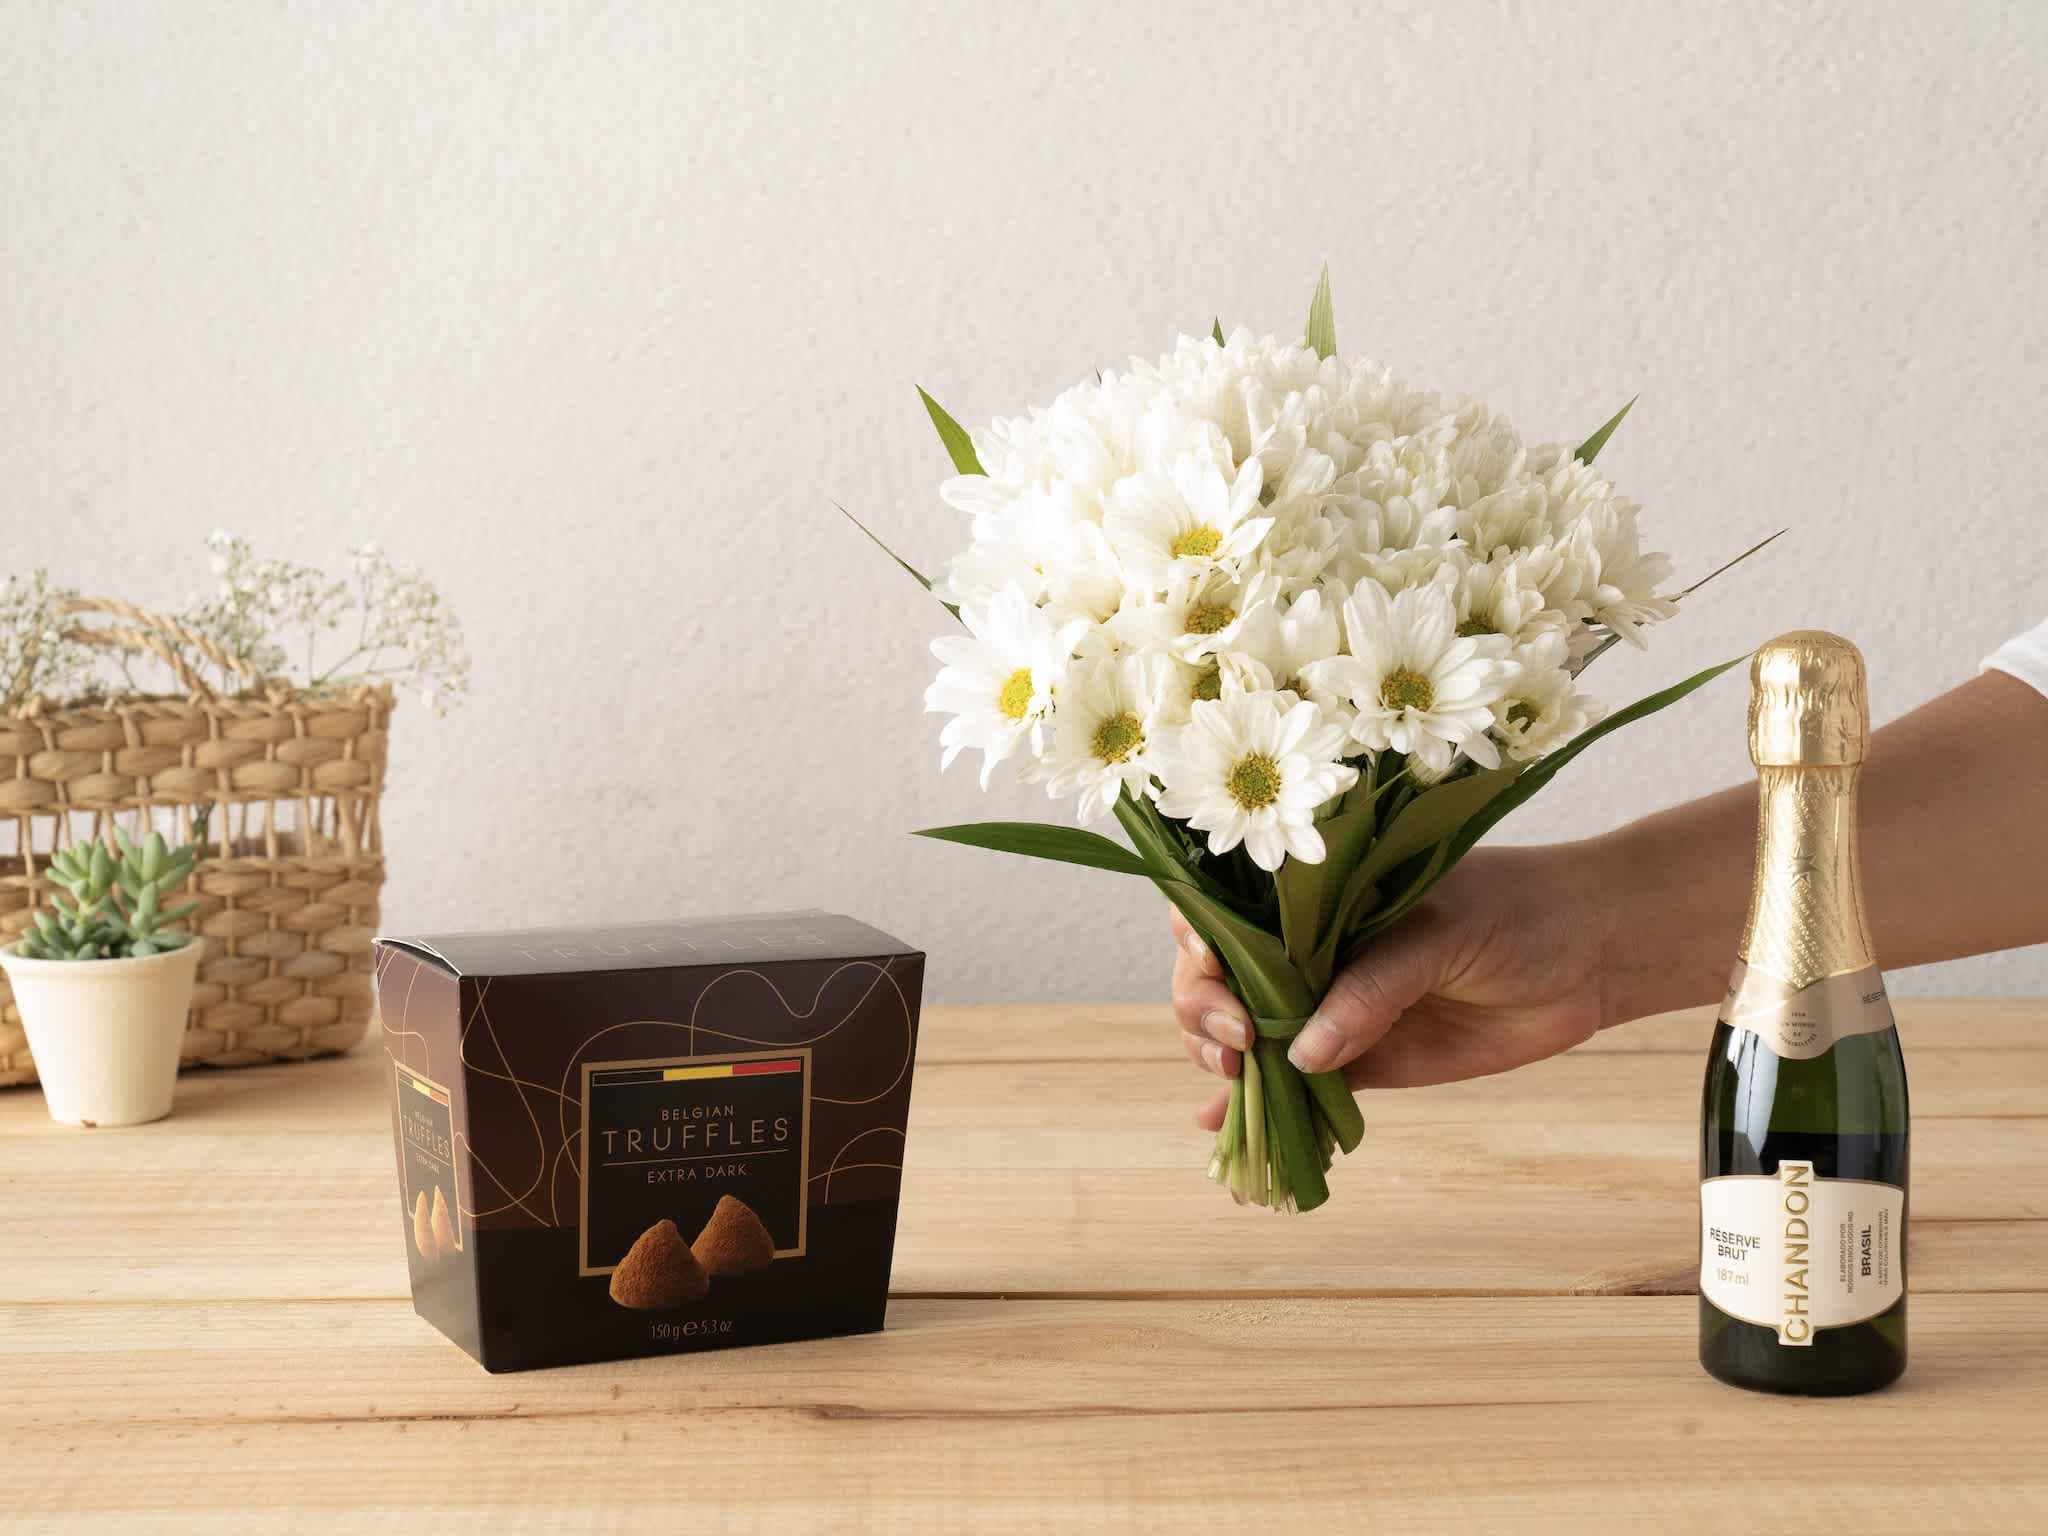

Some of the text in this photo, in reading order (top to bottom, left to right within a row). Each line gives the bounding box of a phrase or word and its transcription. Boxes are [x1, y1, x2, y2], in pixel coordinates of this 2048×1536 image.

[520, 935, 826, 961] TRUFFLES
[661, 1104, 735, 1121] BELGIAN
[401, 1113, 449, 1159] TRUFFLES
[600, 1117, 789, 1155] TRUFFLES
[647, 1162, 747, 1184] EXTRA DARK
[1718, 1244, 1748, 1261] BRUT
[1784, 1165, 1809, 1342] CHANDON
[1861, 1224, 1872, 1277] BRASIL
[651, 1323, 670, 1340] 150
